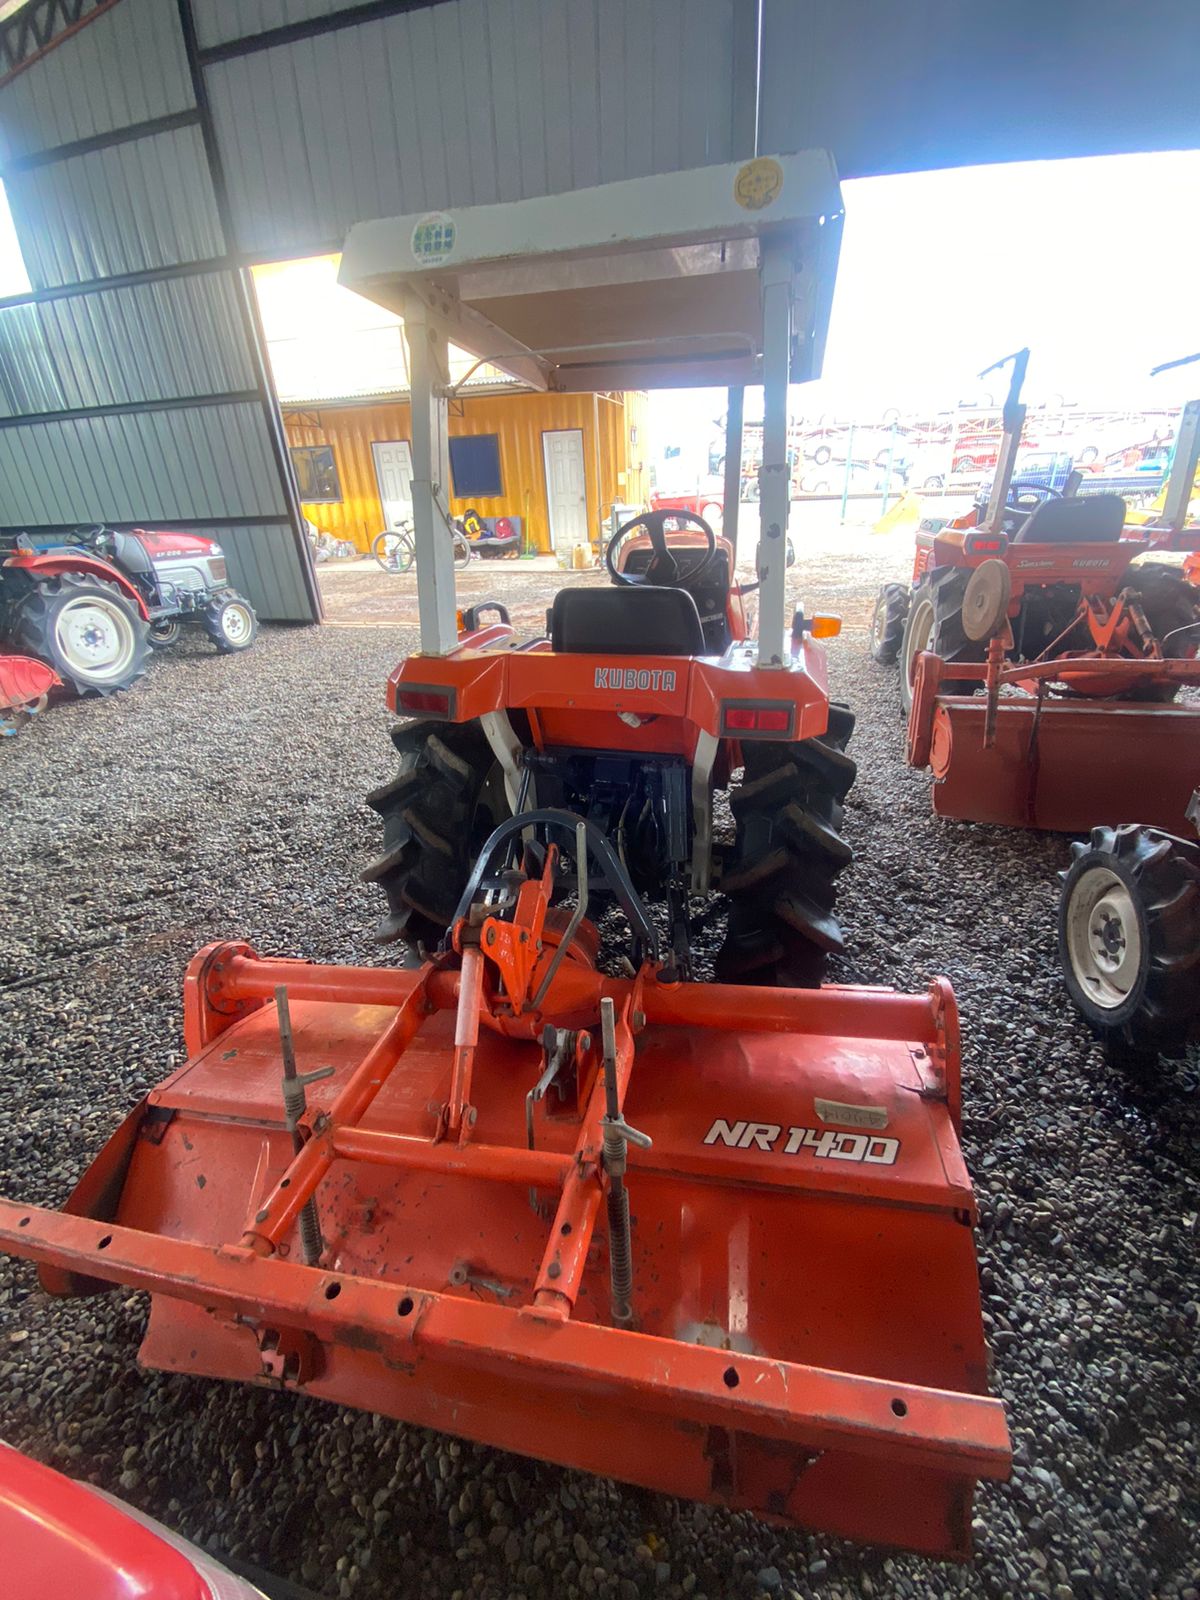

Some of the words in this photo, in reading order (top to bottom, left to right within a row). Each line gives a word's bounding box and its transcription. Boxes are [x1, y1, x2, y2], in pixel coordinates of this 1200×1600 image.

[594, 667, 677, 691] KUBOTA
[703, 1118, 782, 1151] NR
[784, 1127, 900, 1165] 1400
